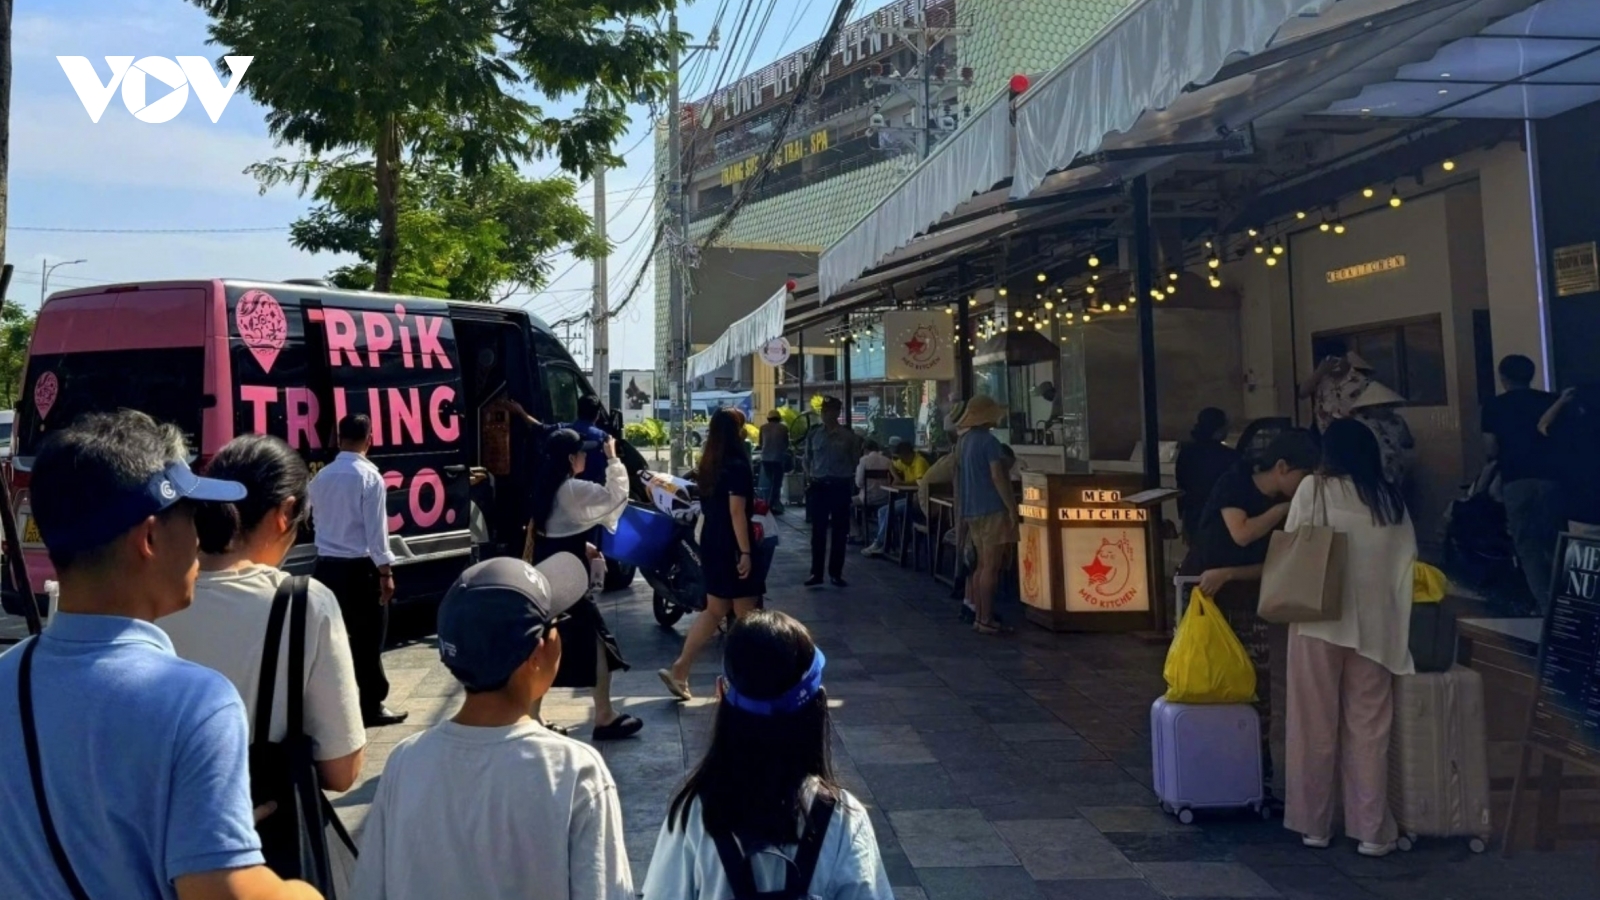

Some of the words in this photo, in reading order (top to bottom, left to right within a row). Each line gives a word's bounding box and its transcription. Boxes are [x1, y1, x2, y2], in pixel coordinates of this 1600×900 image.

[723, 74, 763, 121] LONG
[774, 50, 830, 98] BEA
[811, 129, 829, 154] SPA
[1084, 490, 1119, 502] MEO
[1061, 509, 1145, 520] KITCHEN
[1565, 570, 1598, 600] NU
[1078, 588, 1098, 606] MEO
[1101, 586, 1138, 609] KITCHEN
